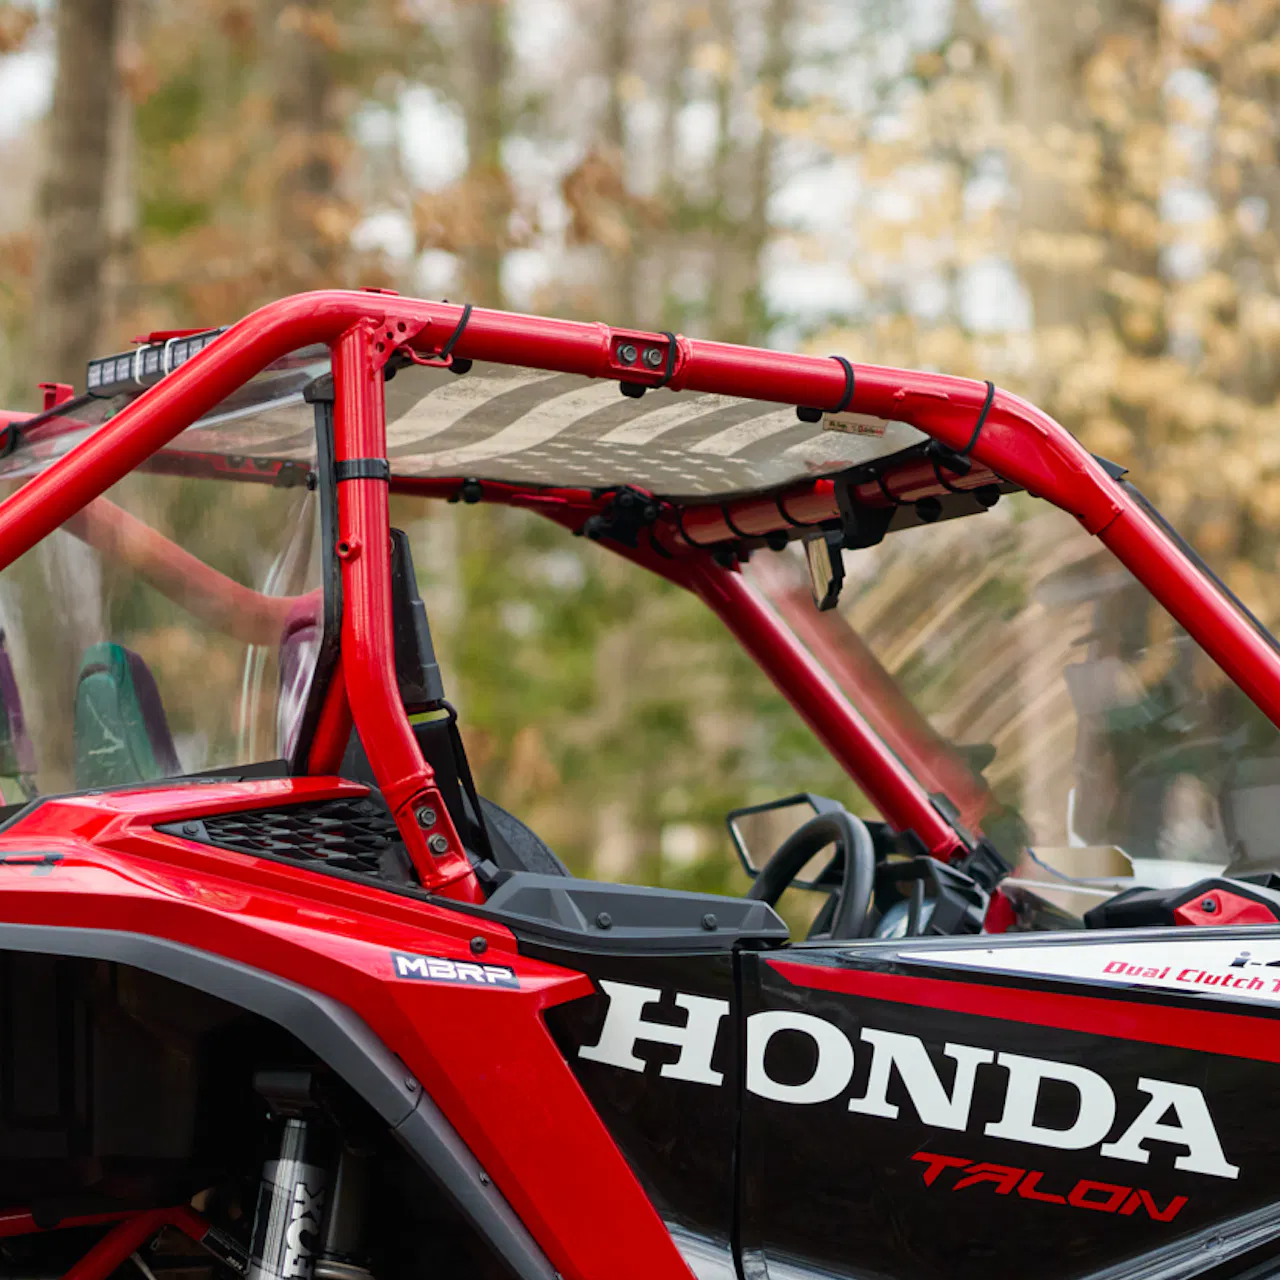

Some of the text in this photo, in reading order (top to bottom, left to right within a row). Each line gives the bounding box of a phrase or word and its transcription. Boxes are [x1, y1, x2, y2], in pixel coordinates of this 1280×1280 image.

[395, 956, 513, 983] MBRP
[1102, 960, 1170, 980] Dual
[1176, 969, 1264, 990] Clutch
[578, 979, 1238, 1179] HONDA
[909, 1151, 1187, 1223] TALON
